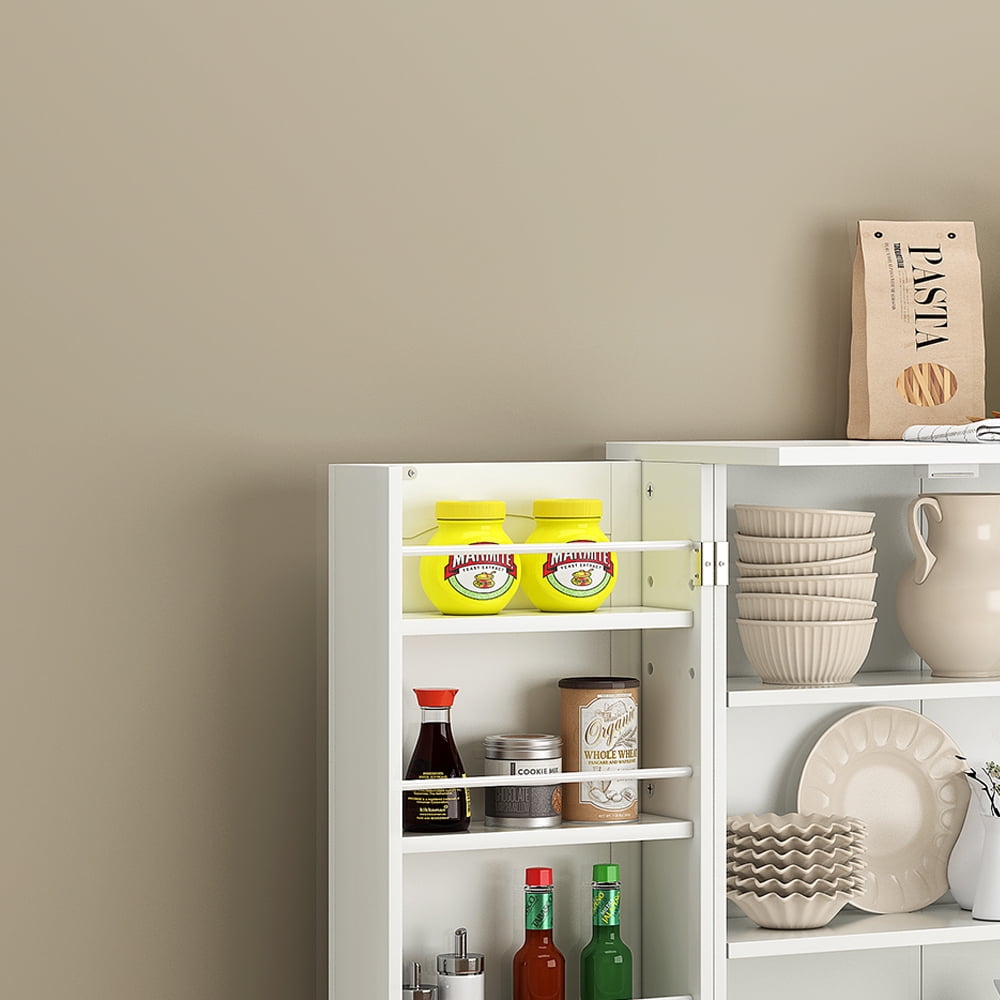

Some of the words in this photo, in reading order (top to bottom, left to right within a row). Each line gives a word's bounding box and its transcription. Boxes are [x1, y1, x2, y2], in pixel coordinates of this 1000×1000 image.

[908, 243, 949, 352] PASTA
[584, 750, 617, 760] WHOLE
[517, 768, 548, 776] COOKIE
